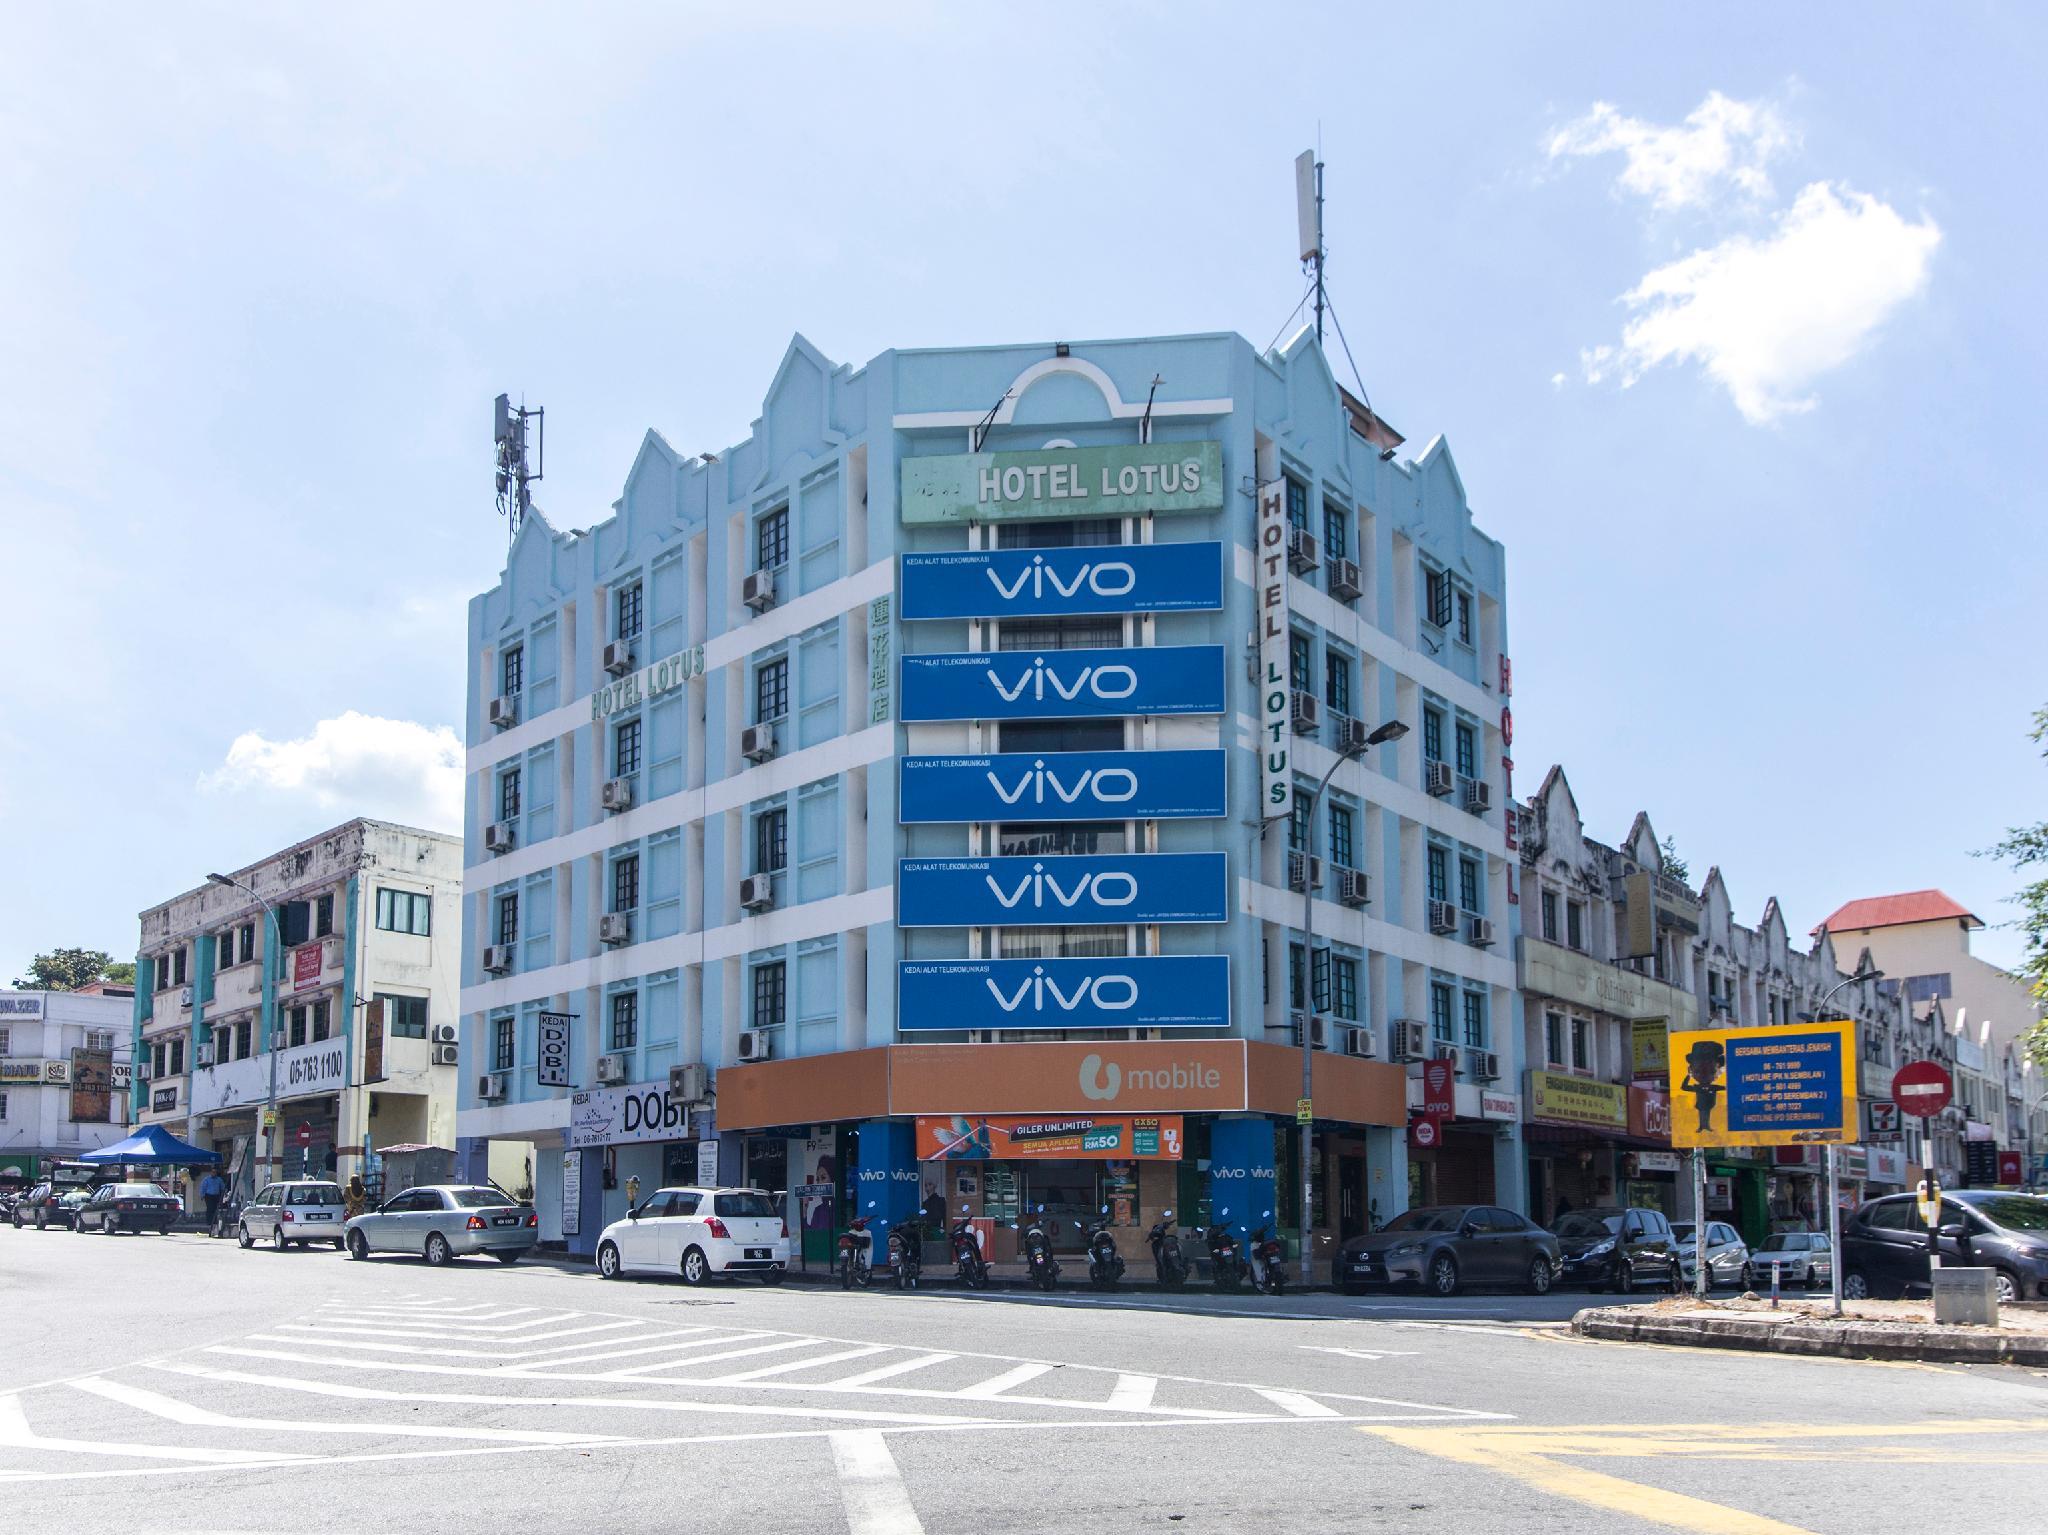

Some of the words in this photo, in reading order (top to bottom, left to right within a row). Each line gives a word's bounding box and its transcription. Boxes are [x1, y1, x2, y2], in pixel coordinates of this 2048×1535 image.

[978, 463, 1088, 503] HOTEL
[1102, 462, 1201, 497] LOTUS
[924, 556, 939, 565] ALAT
[1262, 492, 1283, 639] HOTEL
[986, 554, 1136, 600] vivo
[925, 658, 939, 666] ALAT
[591, 679, 642, 721] HOTEL
[647, 645, 705, 697] LOTUS
[987, 656, 1138, 702] vivo
[1265, 661, 1287, 804] LOTUS
[924, 760, 939, 769] ALAT
[1499, 653, 1519, 905] HOTEL
[987, 759, 1138, 804] vivo
[922, 863, 937, 871] ALAT
[985, 862, 1138, 908] vivo
[922, 966, 937, 974] ALAT
[985, 965, 1139, 1012] vivo
[542, 1016, 567, 1026] KEDAI
[290, 1056, 319, 1085] 06-763
[320, 1050, 342, 1080] 1100
[545, 1029, 562, 1081] DOBI
[1127, 1062, 1220, 1090] mobile
[572, 1092, 590, 1106] KEDAI
[1016, 1124, 1044, 1135] GILER
[1044, 1120, 1093, 1133] UNLIMITED
[859, 1168, 886, 1182] vivo
[890, 1168, 919, 1182] vivo
[1212, 1166, 1245, 1179] vivo
